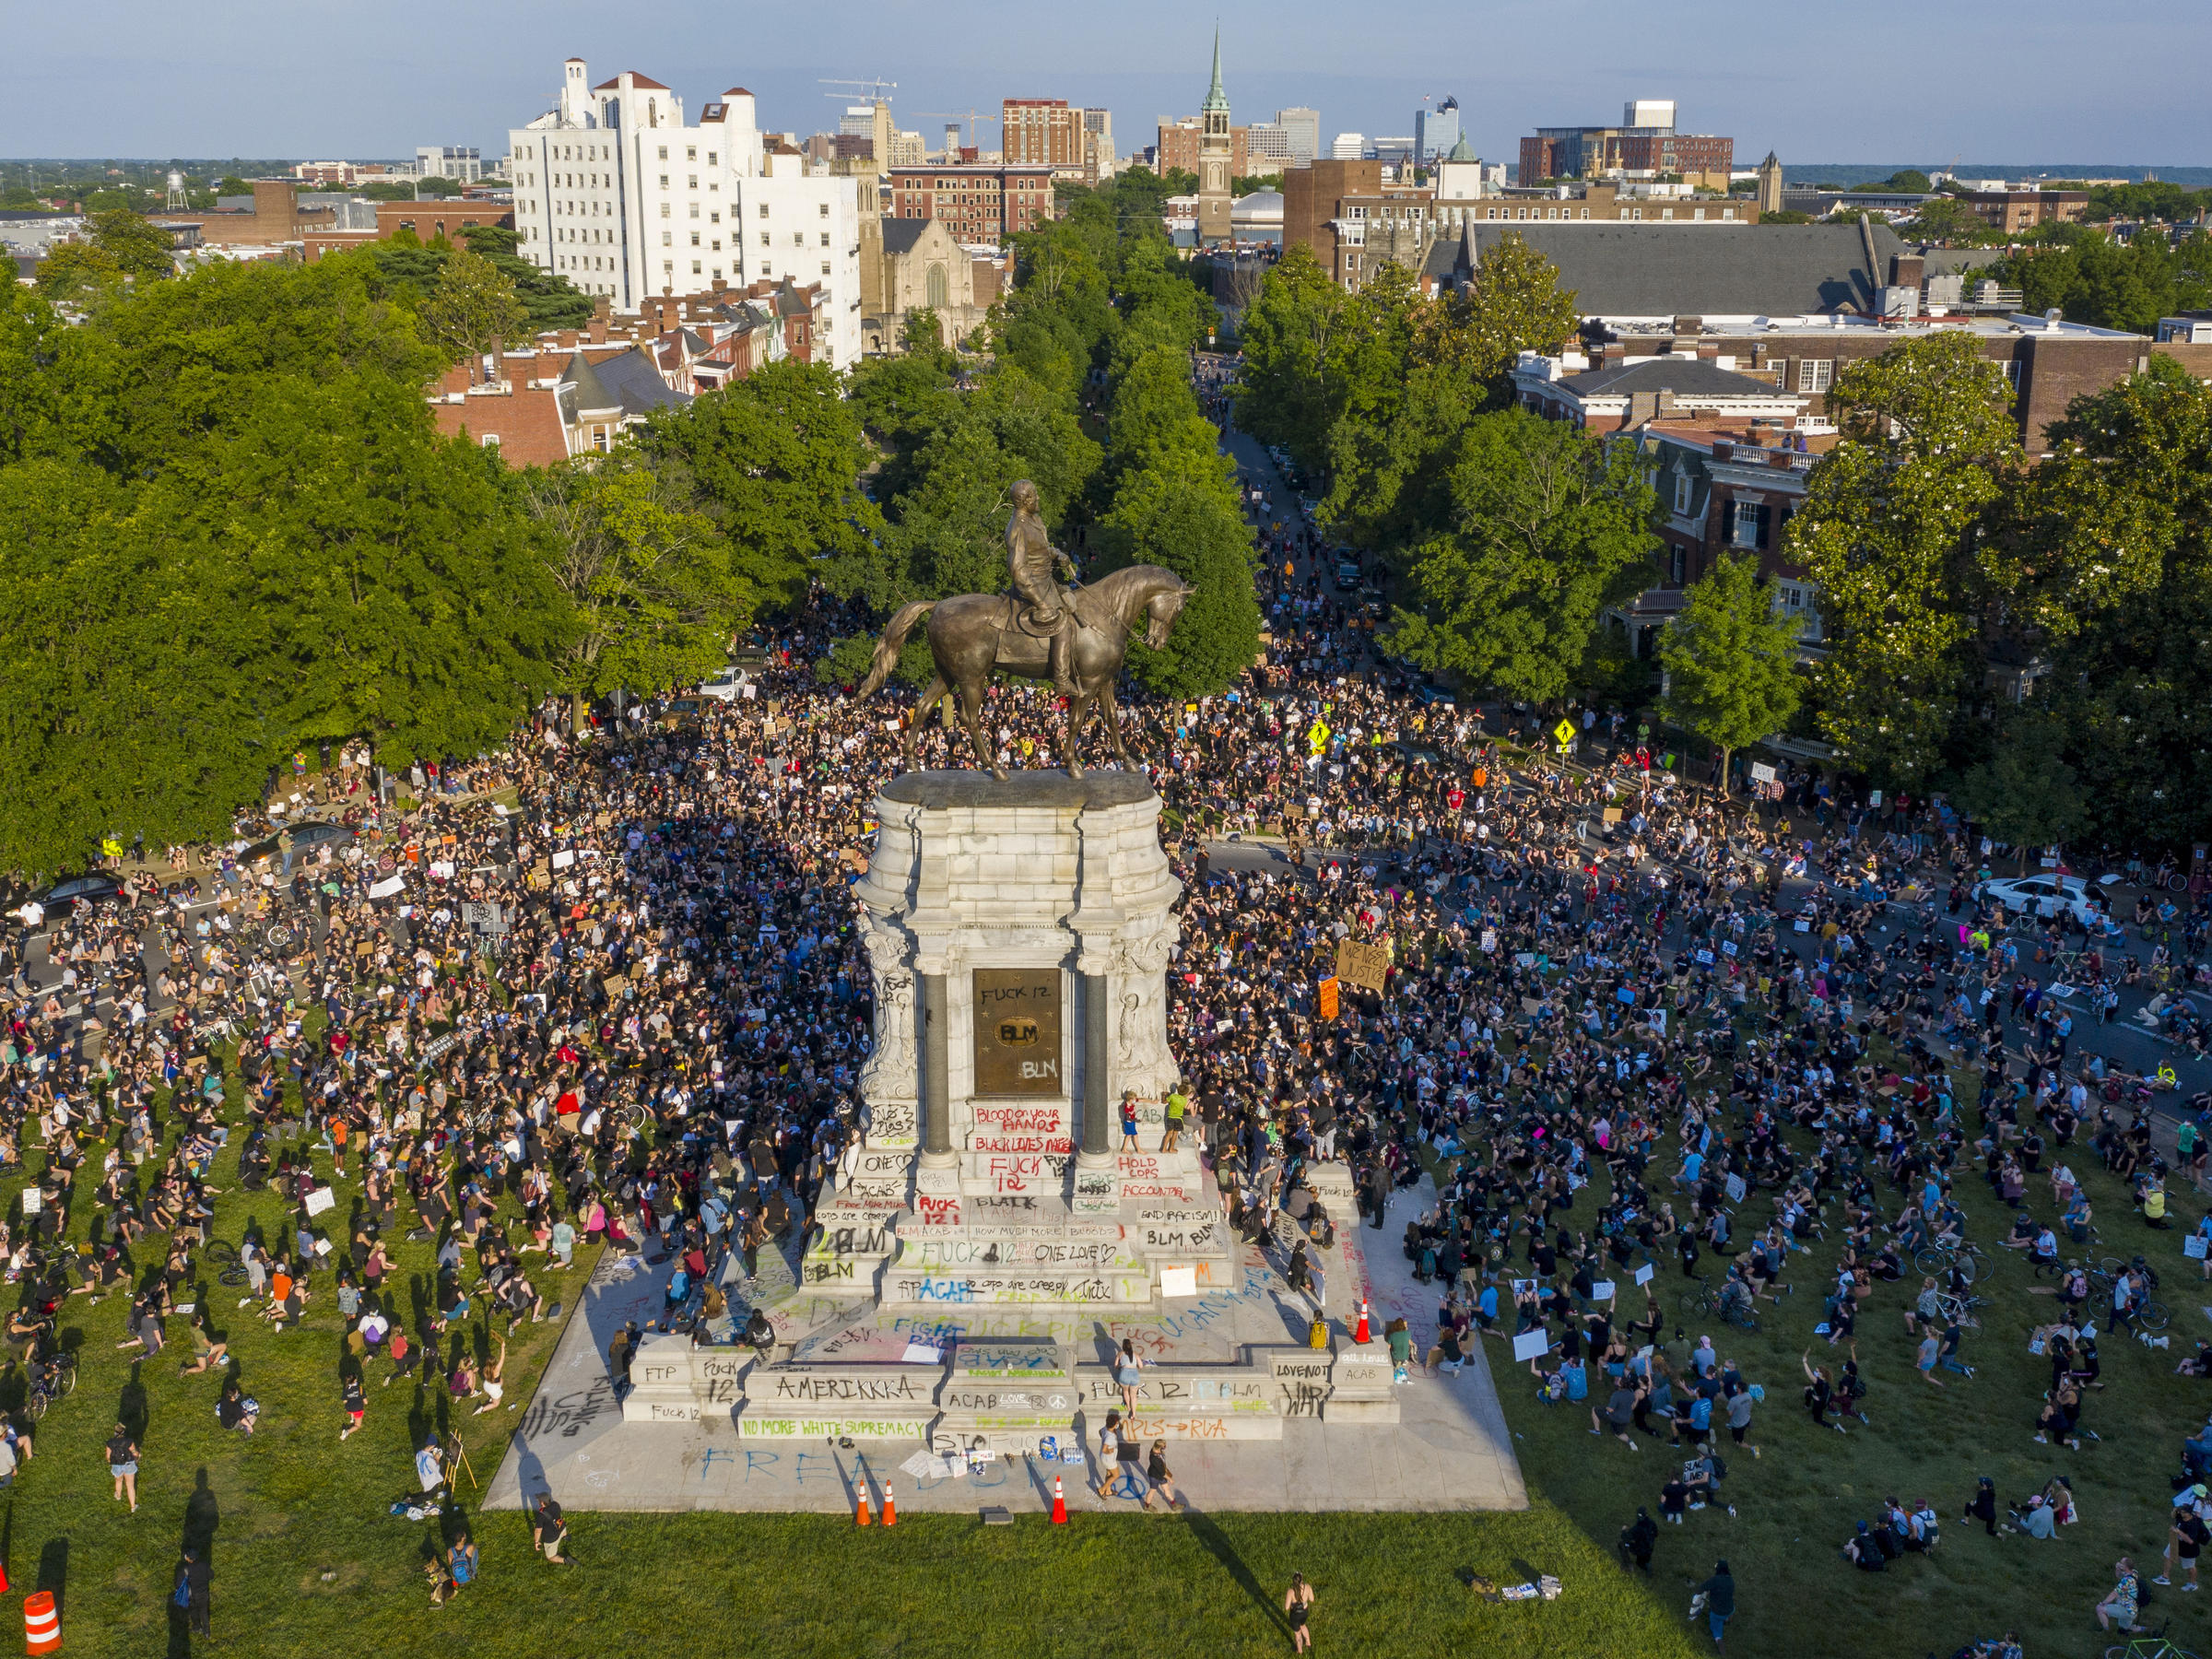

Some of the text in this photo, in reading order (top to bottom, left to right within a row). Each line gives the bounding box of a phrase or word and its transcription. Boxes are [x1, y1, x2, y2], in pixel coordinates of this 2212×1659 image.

[1345, 942, 1388, 969] WE NEED
[1341, 962, 1385, 983] JUSTICE
[981, 986, 1051, 1005] FUCK 12
[1000, 1025, 1038, 1041] BLM
[1022, 1058, 1057, 1079] BLM
[977, 1109, 1014, 1124] BLOOD
[1002, 1120, 1061, 1133] HANDS
[976, 1137, 1010, 1153] BLACK
[1012, 1137, 1043, 1152] LIVES
[865, 1155, 896, 1171] ONE
[990, 1157, 1042, 1176] FUCK
[1043, 1155, 1077, 1167] FUCK
[1118, 1157, 1158, 1171] HOLD
[1053, 1166, 1066, 1177] 12
[1129, 1168, 1159, 1179] COPS
[861, 1183, 896, 1199] ACAB
[998, 1172, 1027, 1193] 12
[919, 1196, 960, 1212] FUCK
[817, 1212, 891, 1224] cops are creepy
[1141, 1210, 1218, 1222] END RACISM!
[834, 1226, 886, 1253] BLM
[922, 1227, 952, 1237] ACAB
[975, 1228, 995, 1236] HOW
[999, 1227, 1028, 1236] MUCH
[1031, 1228, 1062, 1237] MORE
[1147, 1224, 1216, 1246] BLM BLM
[922, 1242, 1021, 1265] FUCK 12
[1035, 1244, 1100, 1262] ONE LOVE
[817, 1263, 853, 1282] BLM
[1007, 1280, 1026, 1290] are
[1030, 1278, 1069, 1298] creepy
[823, 1329, 861, 1353] FUCK
[894, 1318, 966, 1347] FIGHT
[1110, 1322, 1174, 1354] FUCK
[958, 1354, 1043, 1369] ACAB
[1342, 1353, 1389, 1364] all love
[646, 1367, 677, 1381] FTP
[703, 1358, 736, 1377] FUCK
[1346, 1369, 1377, 1381] ACAB
[709, 1378, 734, 1403] 12
[776, 1374, 916, 1400] AMERIKKKA
[1092, 1382, 1189, 1399] FUK 12
[949, 1394, 998, 1410] ACAB
[999, 1393, 1027, 1403] LOVE
[1281, 1382, 1324, 1417] WAR
[653, 1404, 700, 1421] FUCK 12
[742, 1419, 925, 1439] NO MORE WHITE SUPREMACY
[1191, 1418, 1228, 1439] RVA
[988, 1434, 1035, 1450] FUC
[1684, 1461, 1703, 1473] BLAC
